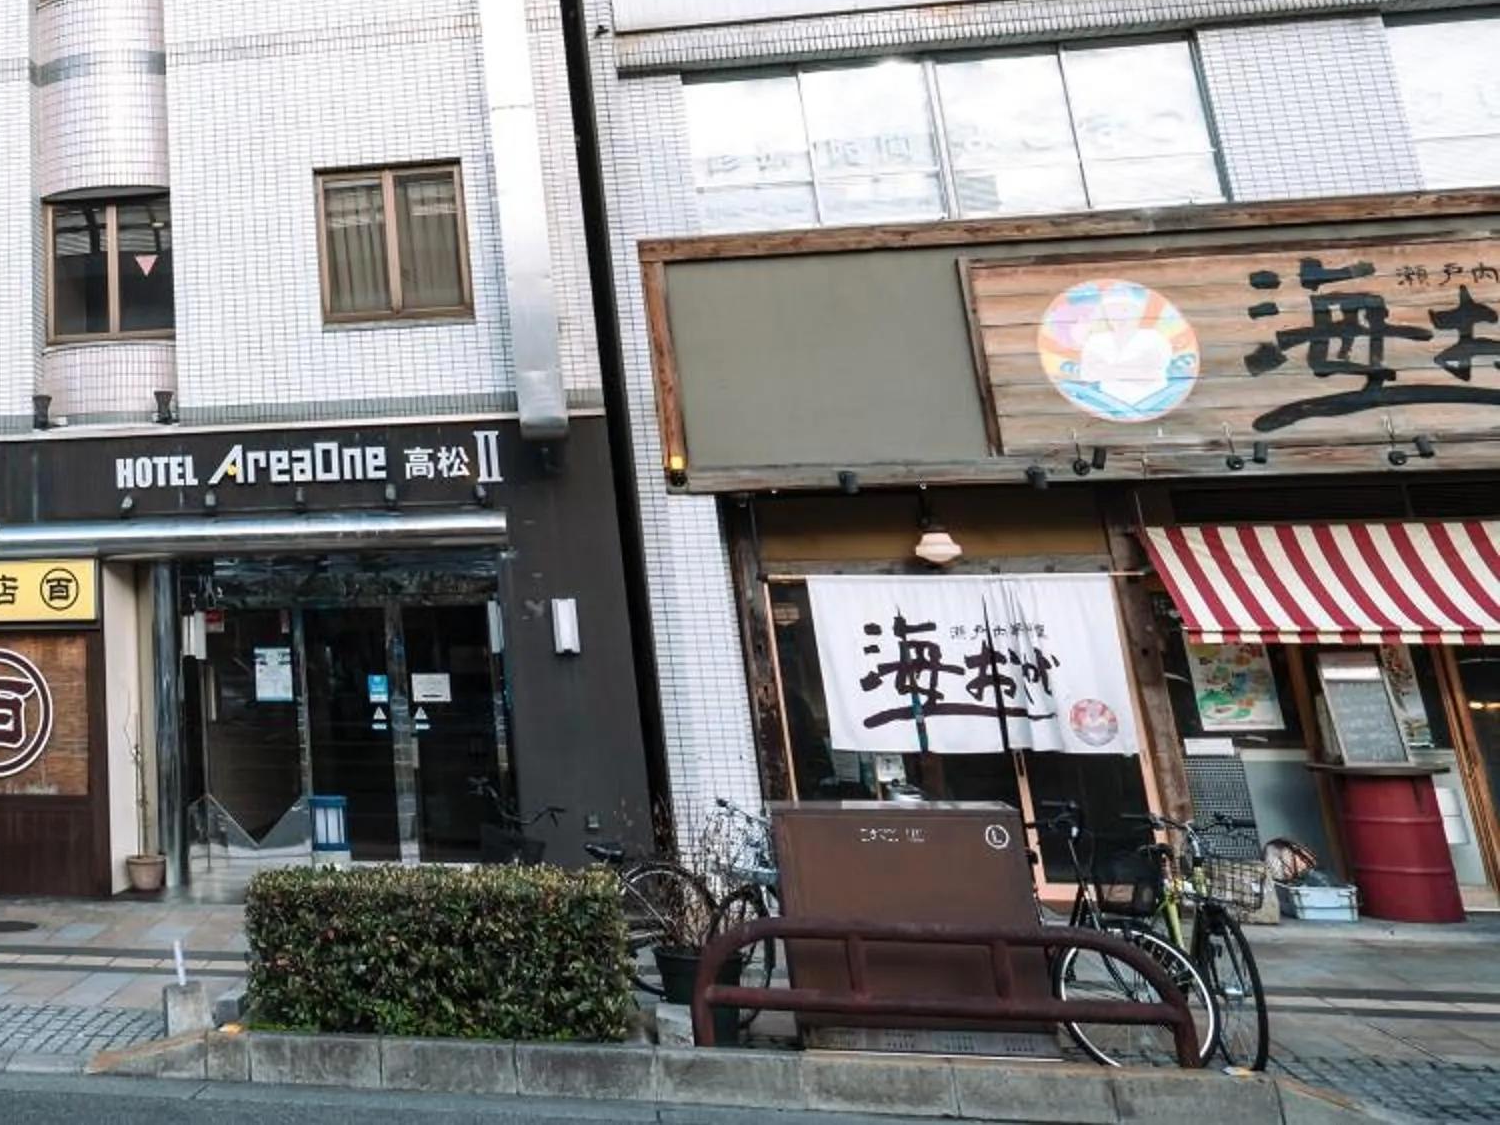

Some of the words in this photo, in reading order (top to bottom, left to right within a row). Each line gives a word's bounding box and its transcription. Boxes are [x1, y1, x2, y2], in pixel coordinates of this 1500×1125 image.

[116, 456, 198, 488] HOTEL
[208, 442, 387, 484] AreaOne
[404, 445, 470, 479] 高松
